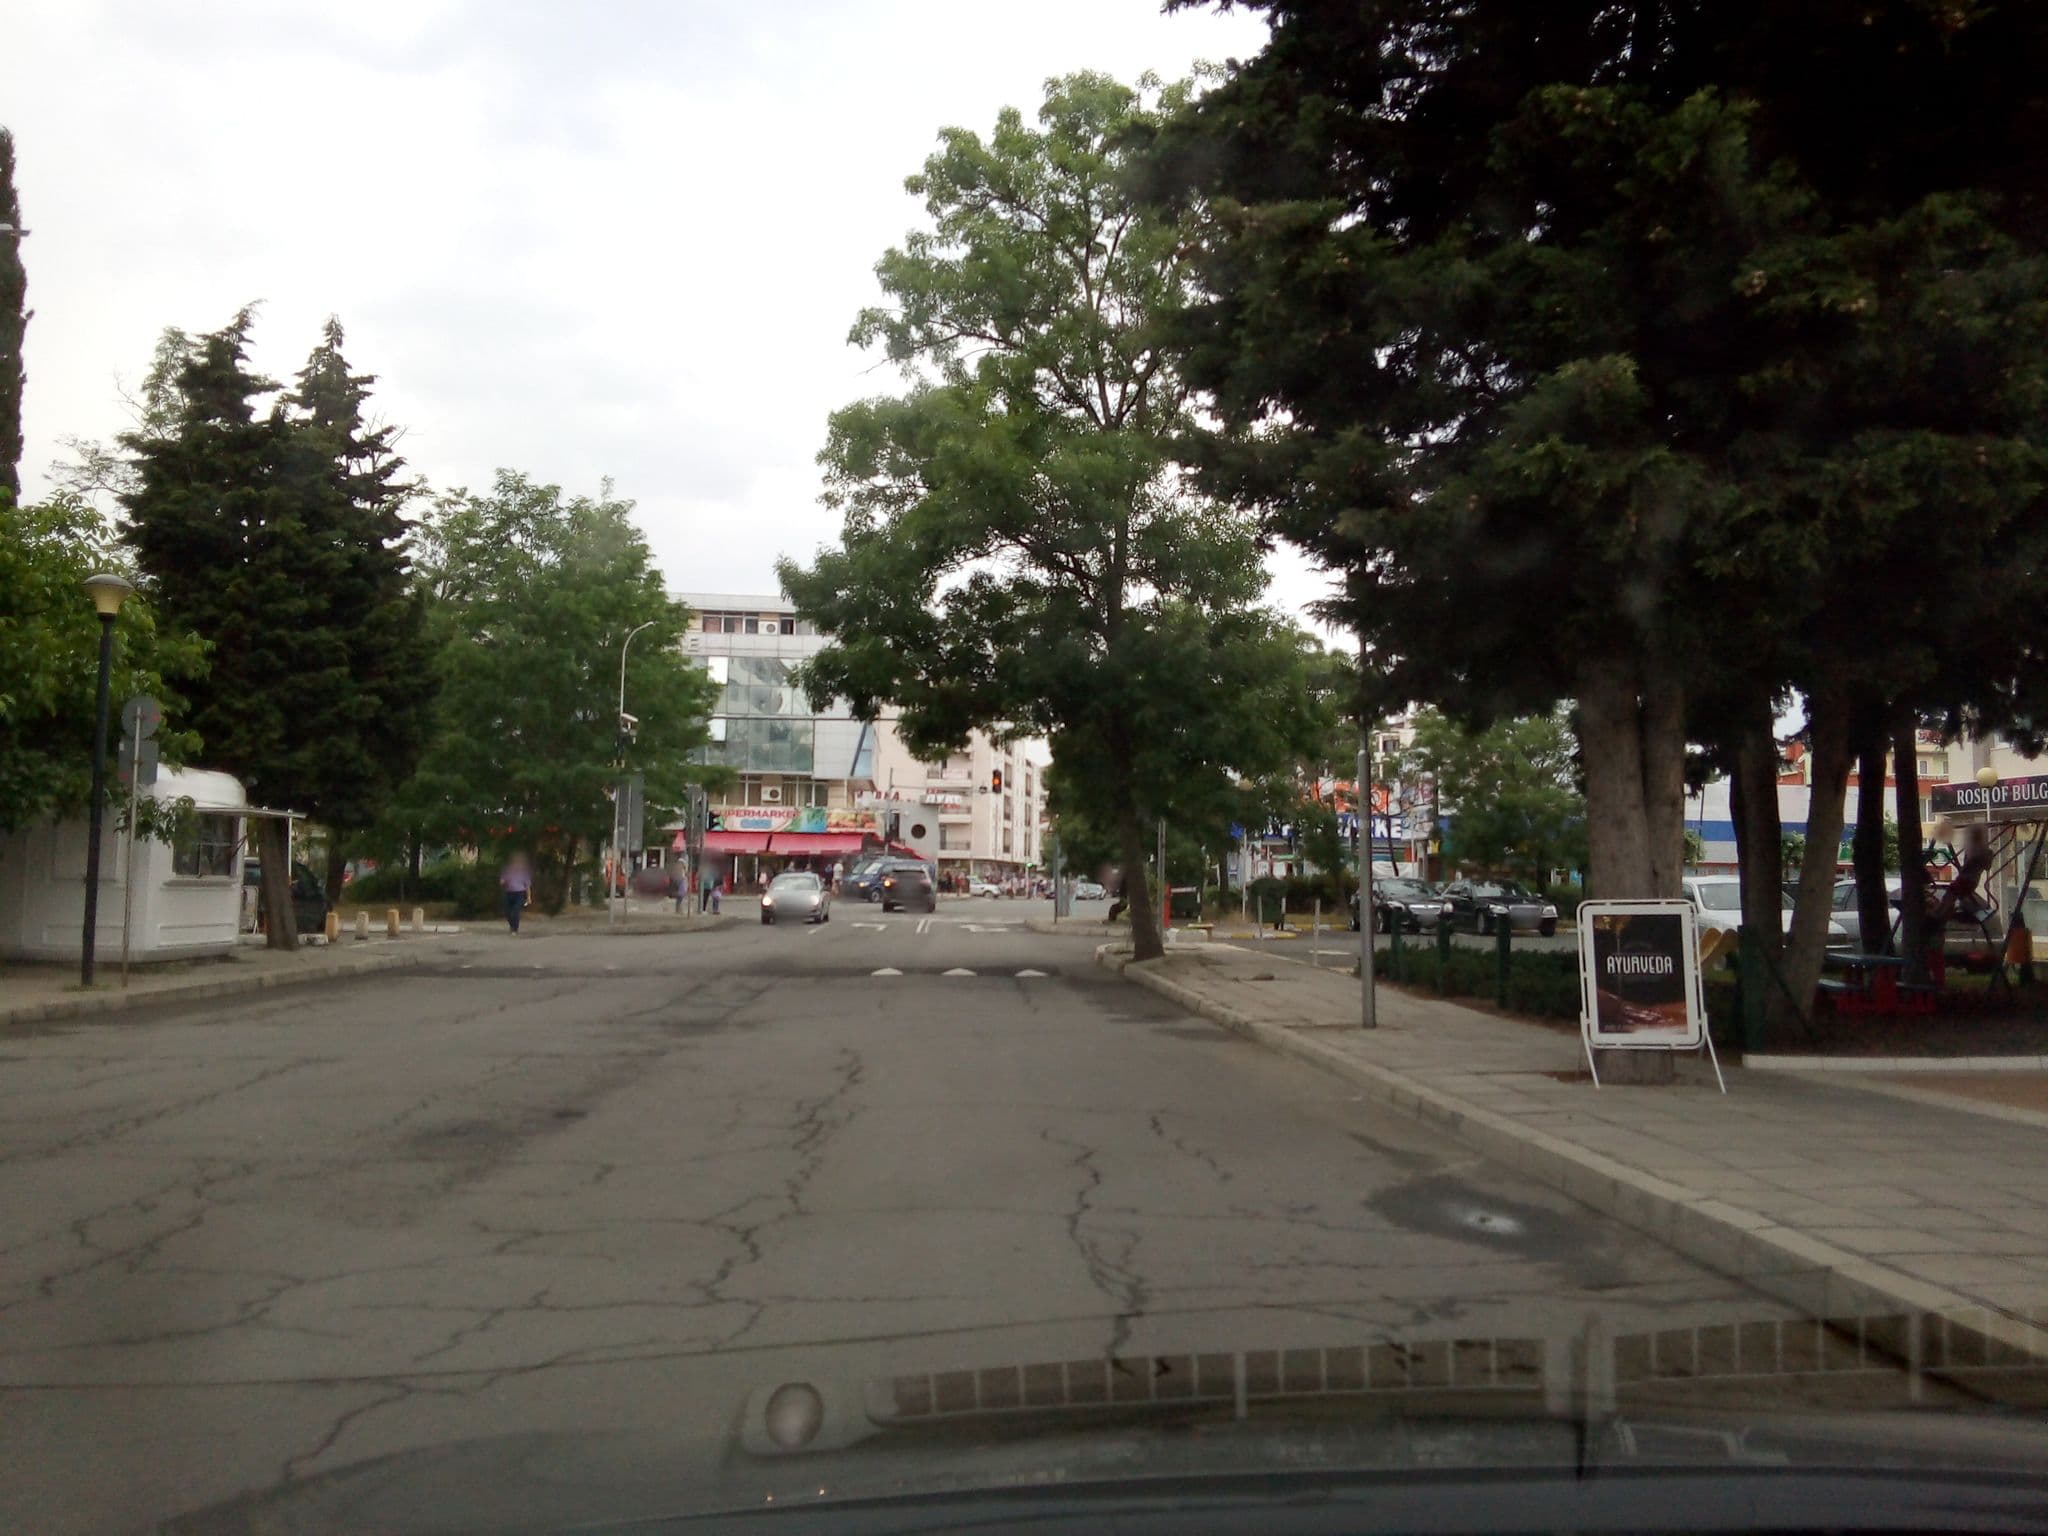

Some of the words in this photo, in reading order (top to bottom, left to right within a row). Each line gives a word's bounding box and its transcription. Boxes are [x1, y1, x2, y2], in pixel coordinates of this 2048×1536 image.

[1957, 787, 1988, 805] ROSE
[1991, 786, 2008, 803] OF
[1606, 955, 1673, 974] AYURVEDA
